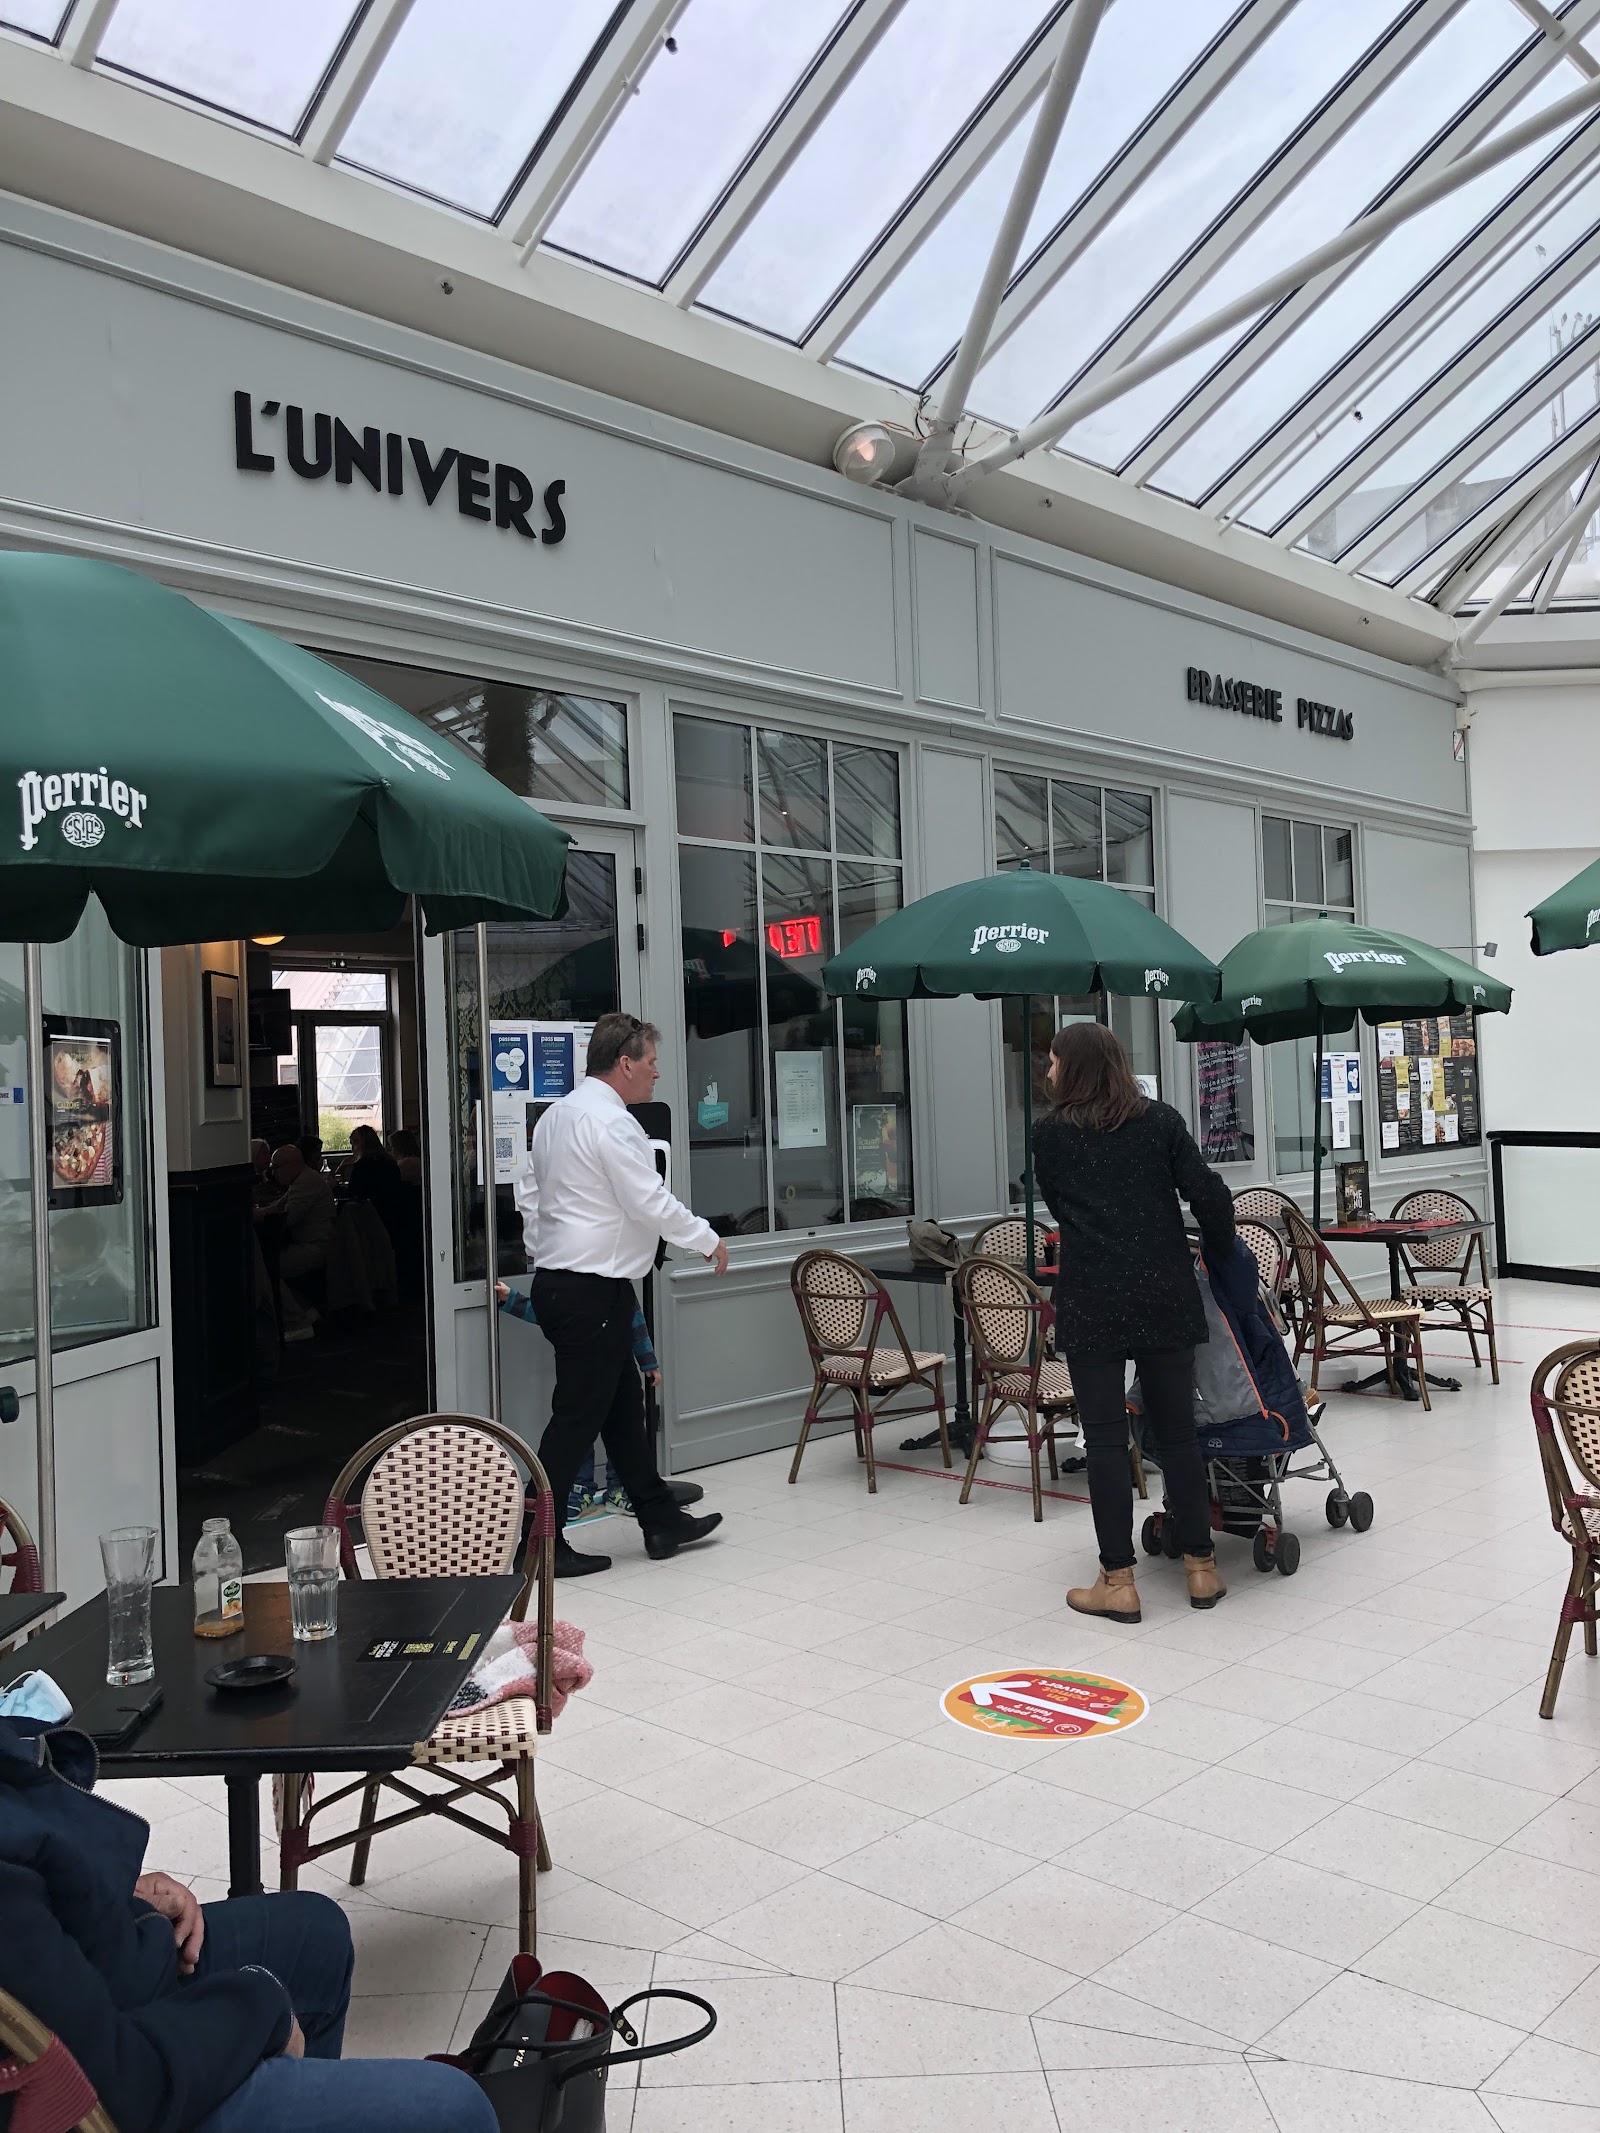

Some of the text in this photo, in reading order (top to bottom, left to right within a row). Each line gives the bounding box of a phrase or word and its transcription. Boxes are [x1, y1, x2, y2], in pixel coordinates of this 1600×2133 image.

[234, 390, 566, 545] L'UNIVERS
[1187, 666, 1354, 741] BRASSERIE PIZZAS
[18, 766, 148, 851] perrier
[970, 922, 1050, 955] perrier
[1323, 949, 1408, 974] perrier
[1046, 1692, 1070, 1702] On
[996, 1704, 1055, 1724] Une petite
